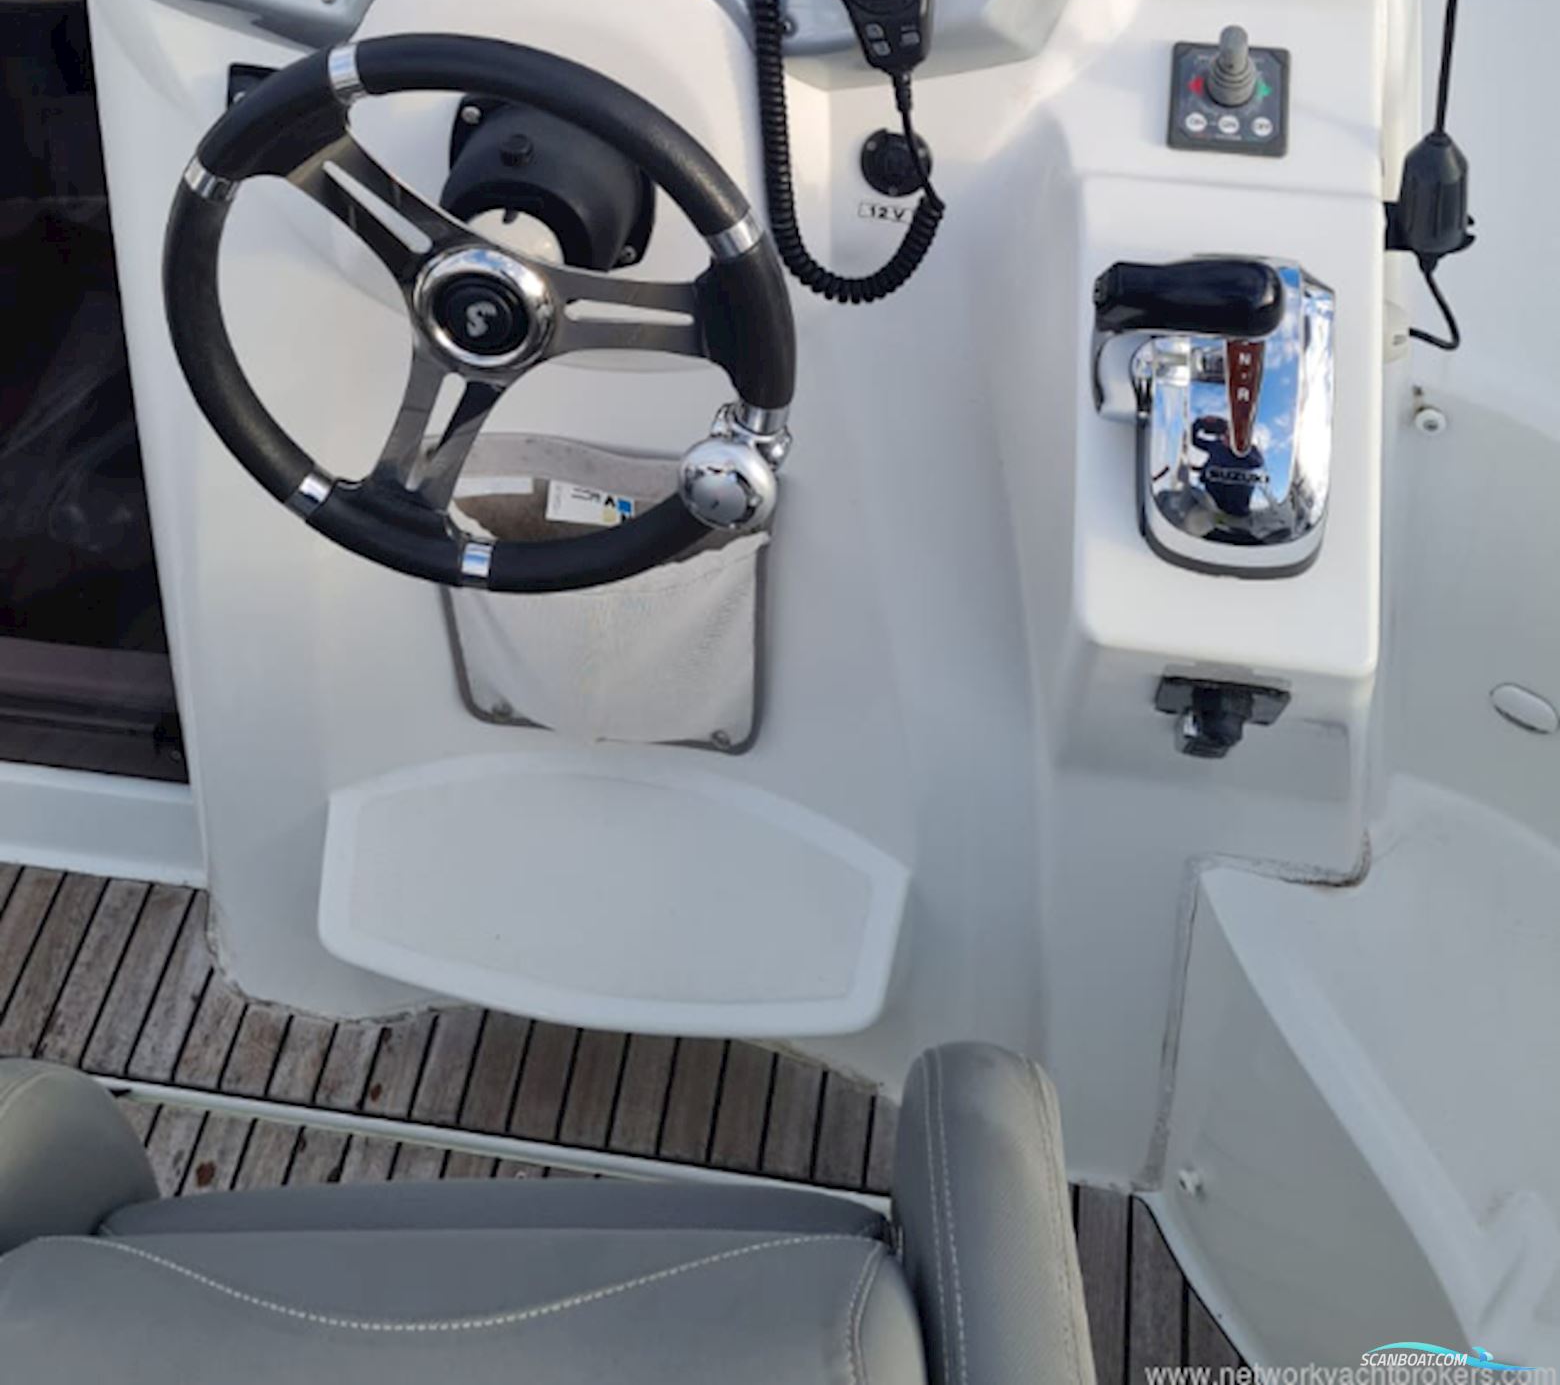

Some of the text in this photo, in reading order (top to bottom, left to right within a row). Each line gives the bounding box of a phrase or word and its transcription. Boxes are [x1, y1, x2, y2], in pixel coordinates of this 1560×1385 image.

[1238, 352, 1252, 365] N
[1236, 386, 1250, 402] R
[1208, 468, 1270, 484] SUZUKI
